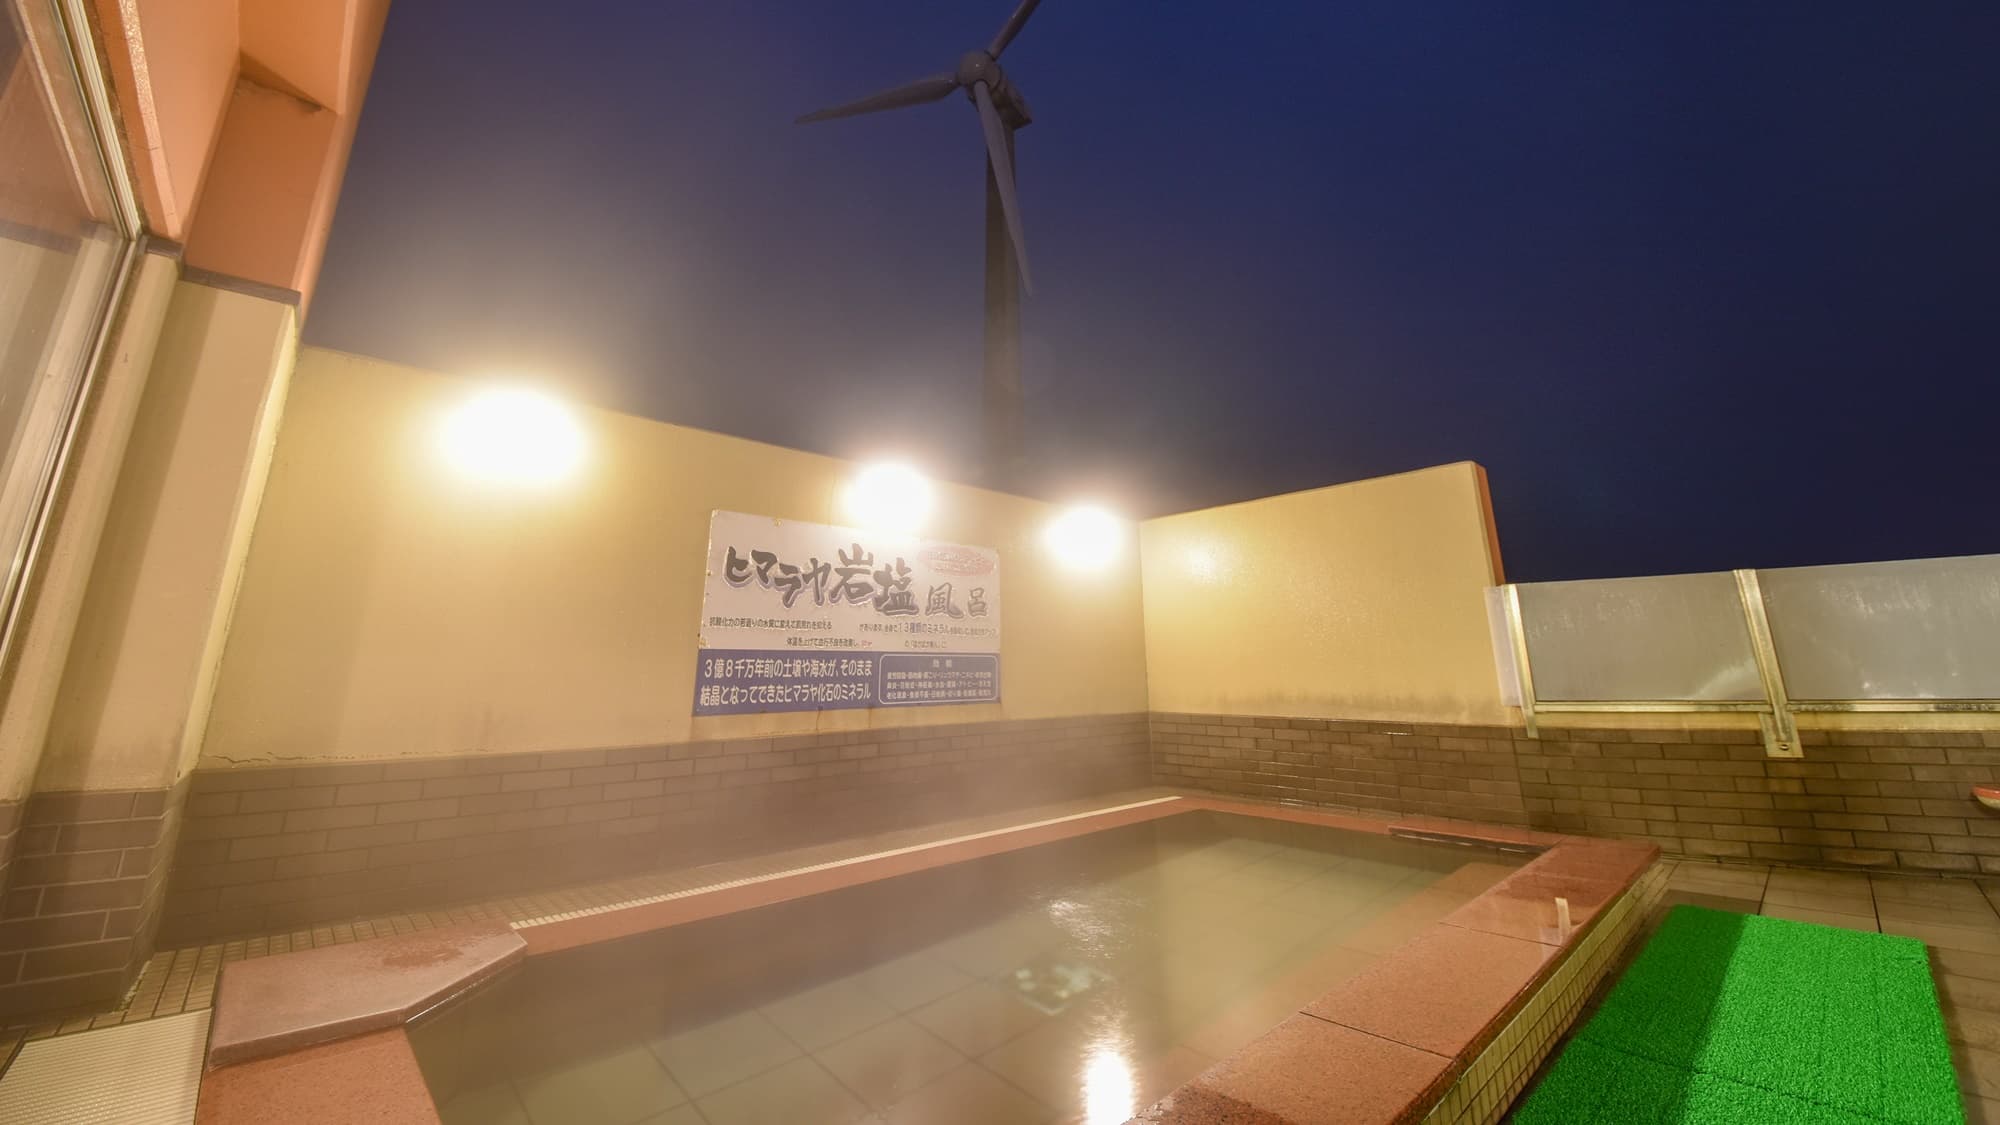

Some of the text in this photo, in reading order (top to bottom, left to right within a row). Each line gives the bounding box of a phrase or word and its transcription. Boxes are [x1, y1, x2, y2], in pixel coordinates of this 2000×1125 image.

[723, 543, 989, 619] ヒマラヤ岩塩風呂
[700, 682, 872, 707] 結晶となってできたヒマラヤ化石のミネラル
